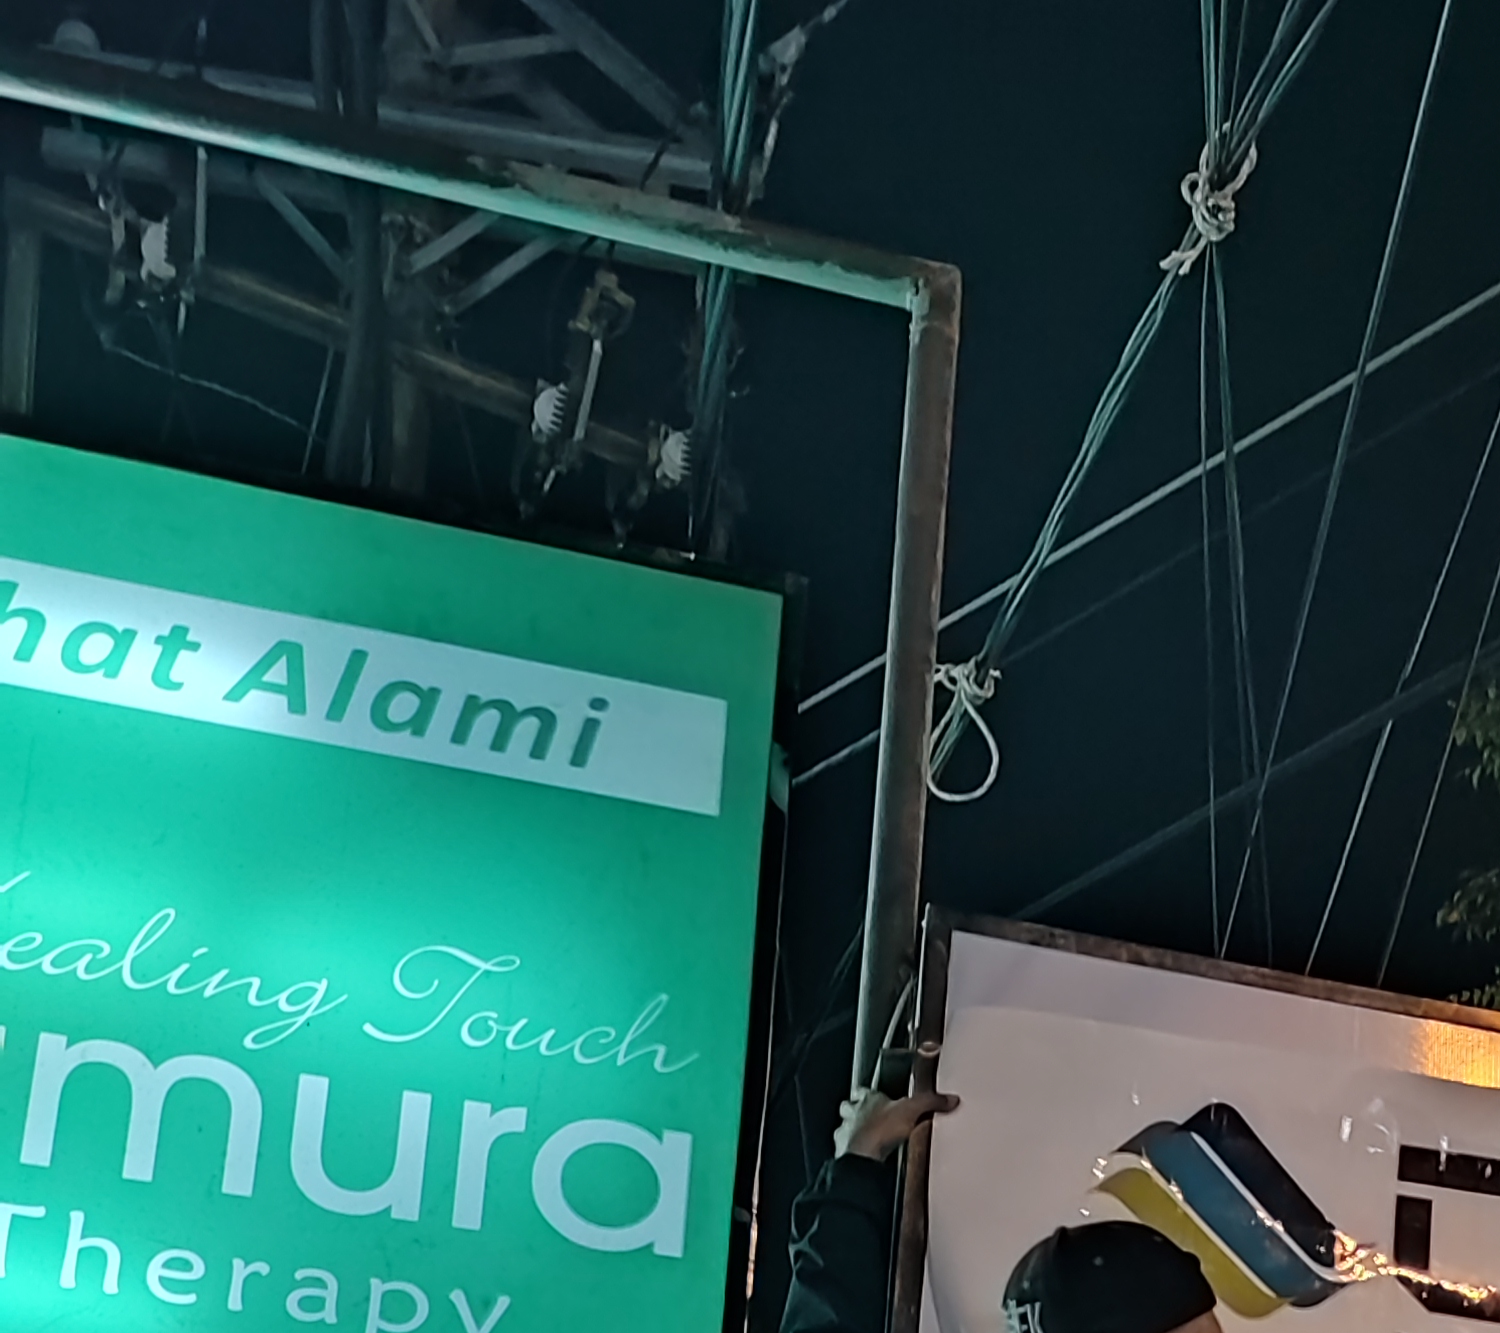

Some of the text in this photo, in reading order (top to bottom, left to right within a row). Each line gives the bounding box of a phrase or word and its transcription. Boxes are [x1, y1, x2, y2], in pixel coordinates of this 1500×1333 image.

[222, 638, 610, 769] Alami
[0, 870, 700, 1074] ealing Touch
[0, 1024, 694, 1259] mura
